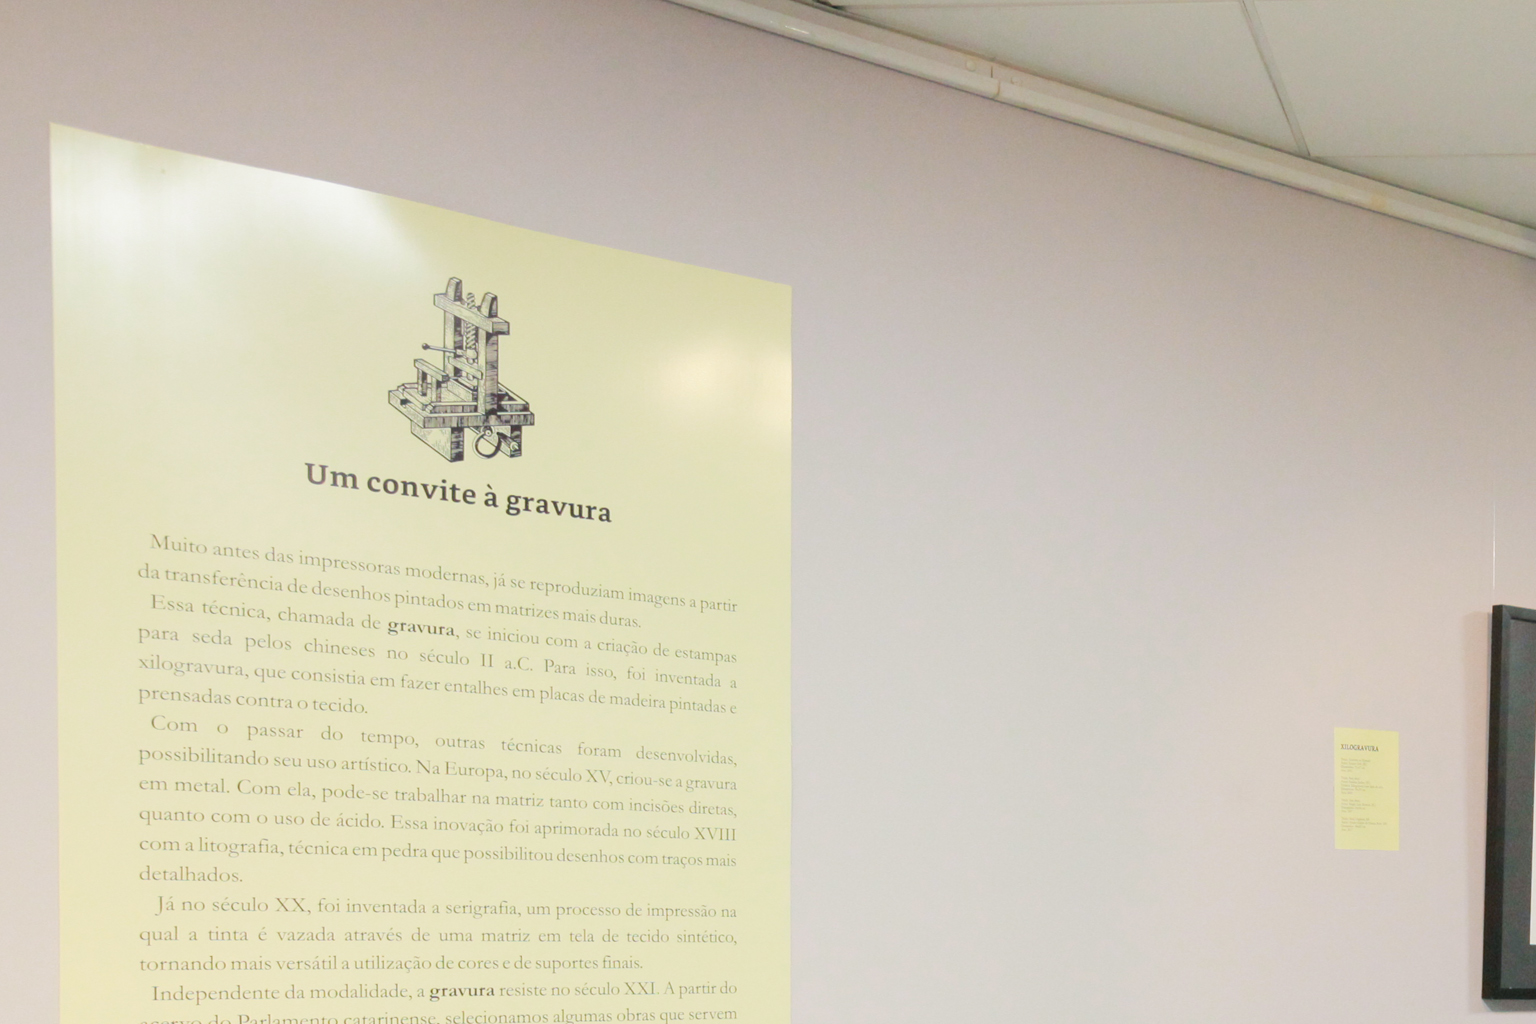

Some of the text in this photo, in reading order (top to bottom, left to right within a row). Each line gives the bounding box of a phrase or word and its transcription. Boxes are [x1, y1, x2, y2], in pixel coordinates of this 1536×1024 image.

[305, 462, 611, 523] Um convite à gravura
[149, 532, 738, 614] Muito antes das impressoras modernas, já se reproduziam imagens a partir
[136, 561, 641, 628] da transferência de desenhos pintados em matrizes mais duras.
[150, 593, 737, 666] Essa técnica, chamada de gravura, se iniciou com a criação de estampas
[137, 653, 737, 714] xilogravura, que consistia em fazer entalhes em placas de madeira pintadas e
[138, 687, 368, 714] prensadas contra o tecido.
[150, 714, 737, 767] Com o passar do tempo, outras técnicas foram desenvolvidas,
[1340, 744, 1379, 752] XILOGRAVURA
[137, 745, 737, 792] possibilitando seu uso artístico. Na Europa, no século XV, criou-se a gravura
[138, 777, 737, 818] em metal. Com ela, pode-se trabalhar na matriz tanto com incisões diretas,
[138, 836, 737, 869] com a litografia, técnica em pedra que possibilitou desenhos com traços mais
[138, 864, 243, 882] detalhados.
[139, 954, 643, 974] tornando mais versátil a utilização de cores e de suportes finais.
[151, 980, 737, 1006] Independente da modalidade, a gravura resiste no século XXI. A partir do
[444, 1009, 548, 1024] selecionamos
[615, 1007, 655, 1021] obras
[688, 1009, 737, 1020] servem
